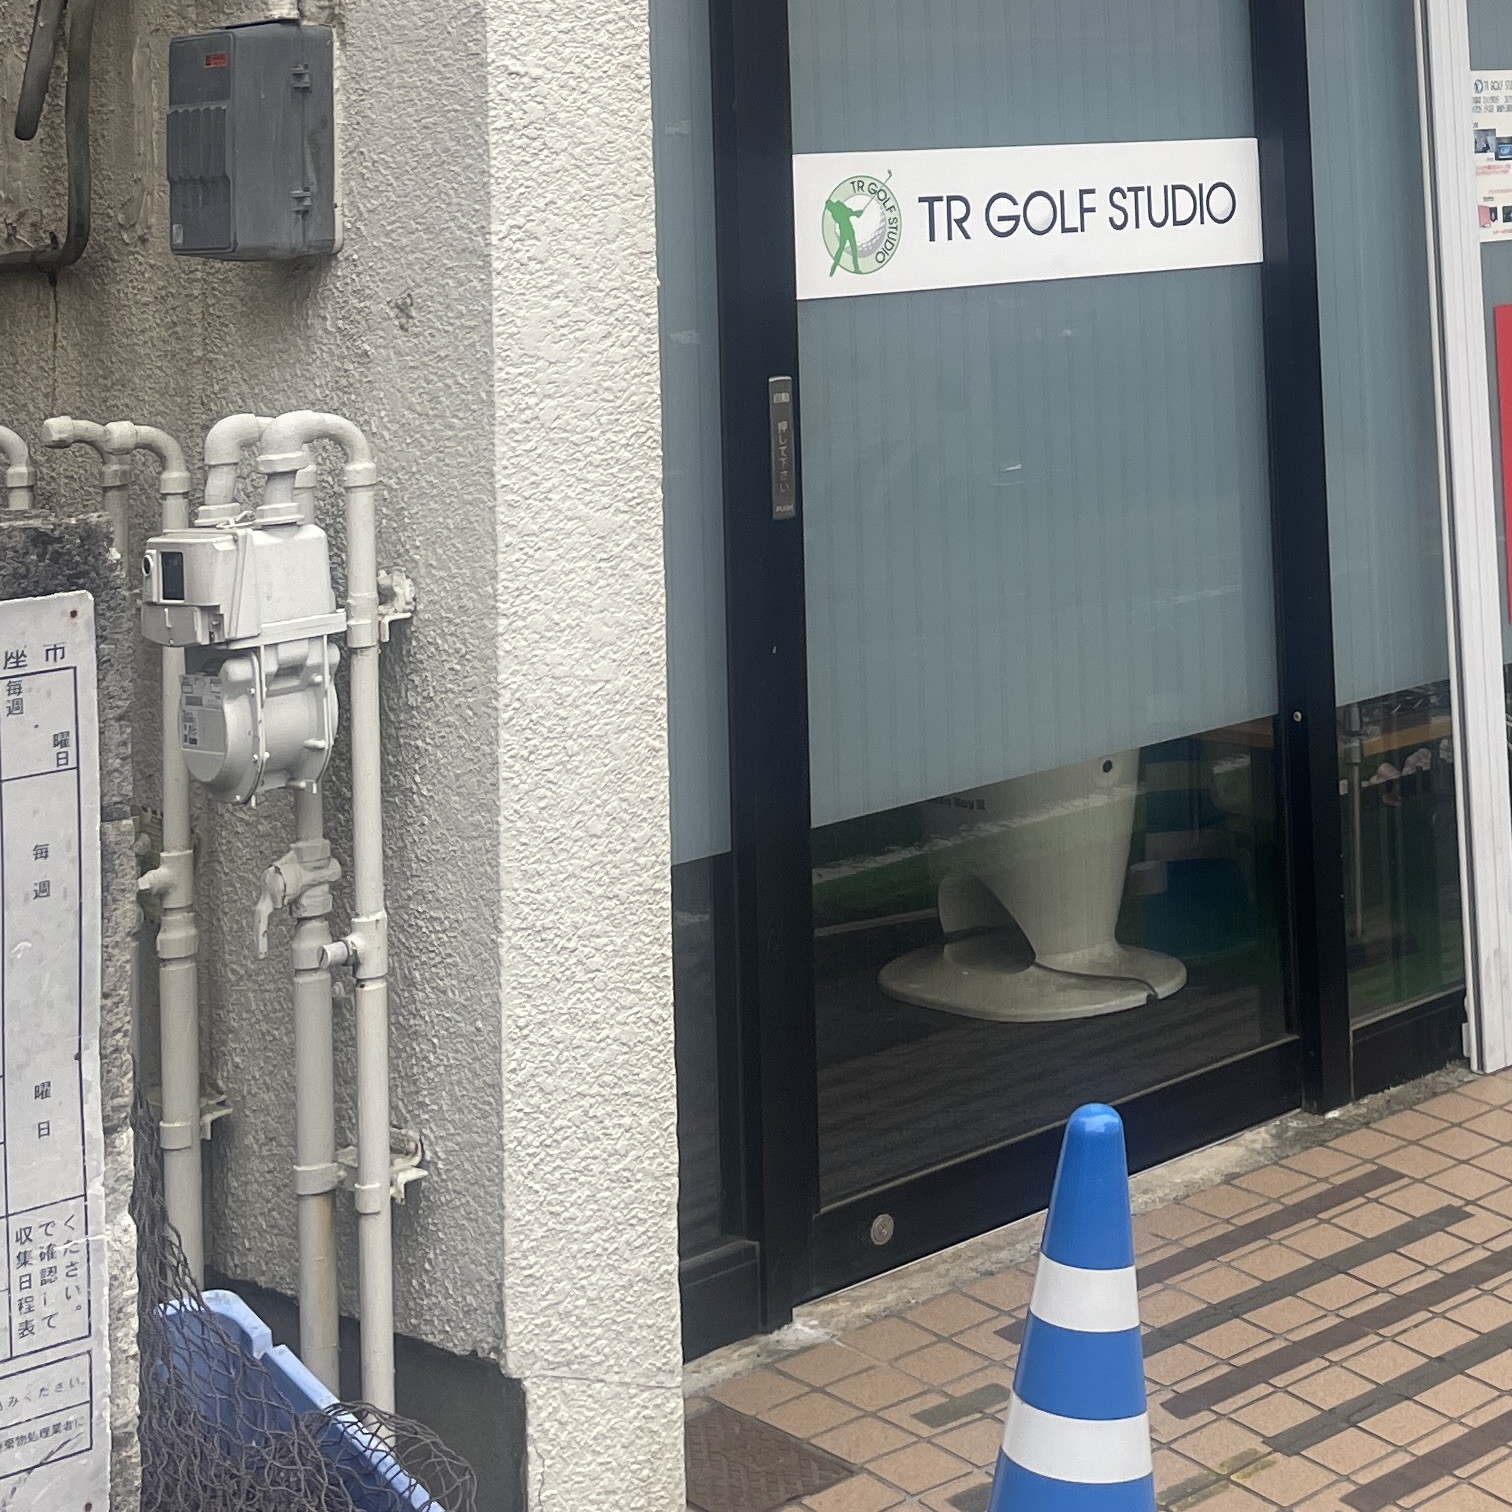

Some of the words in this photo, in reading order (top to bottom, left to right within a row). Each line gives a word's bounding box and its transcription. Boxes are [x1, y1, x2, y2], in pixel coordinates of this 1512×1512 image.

[867, 182, 897, 214] GOLF
[918, 194, 971, 242] TR
[984, 189, 1097, 239] GOLF
[1108, 181, 1237, 231] STUDIO
[875, 216, 899, 264] STUDIO
[52, 730, 70, 768] 曜日
